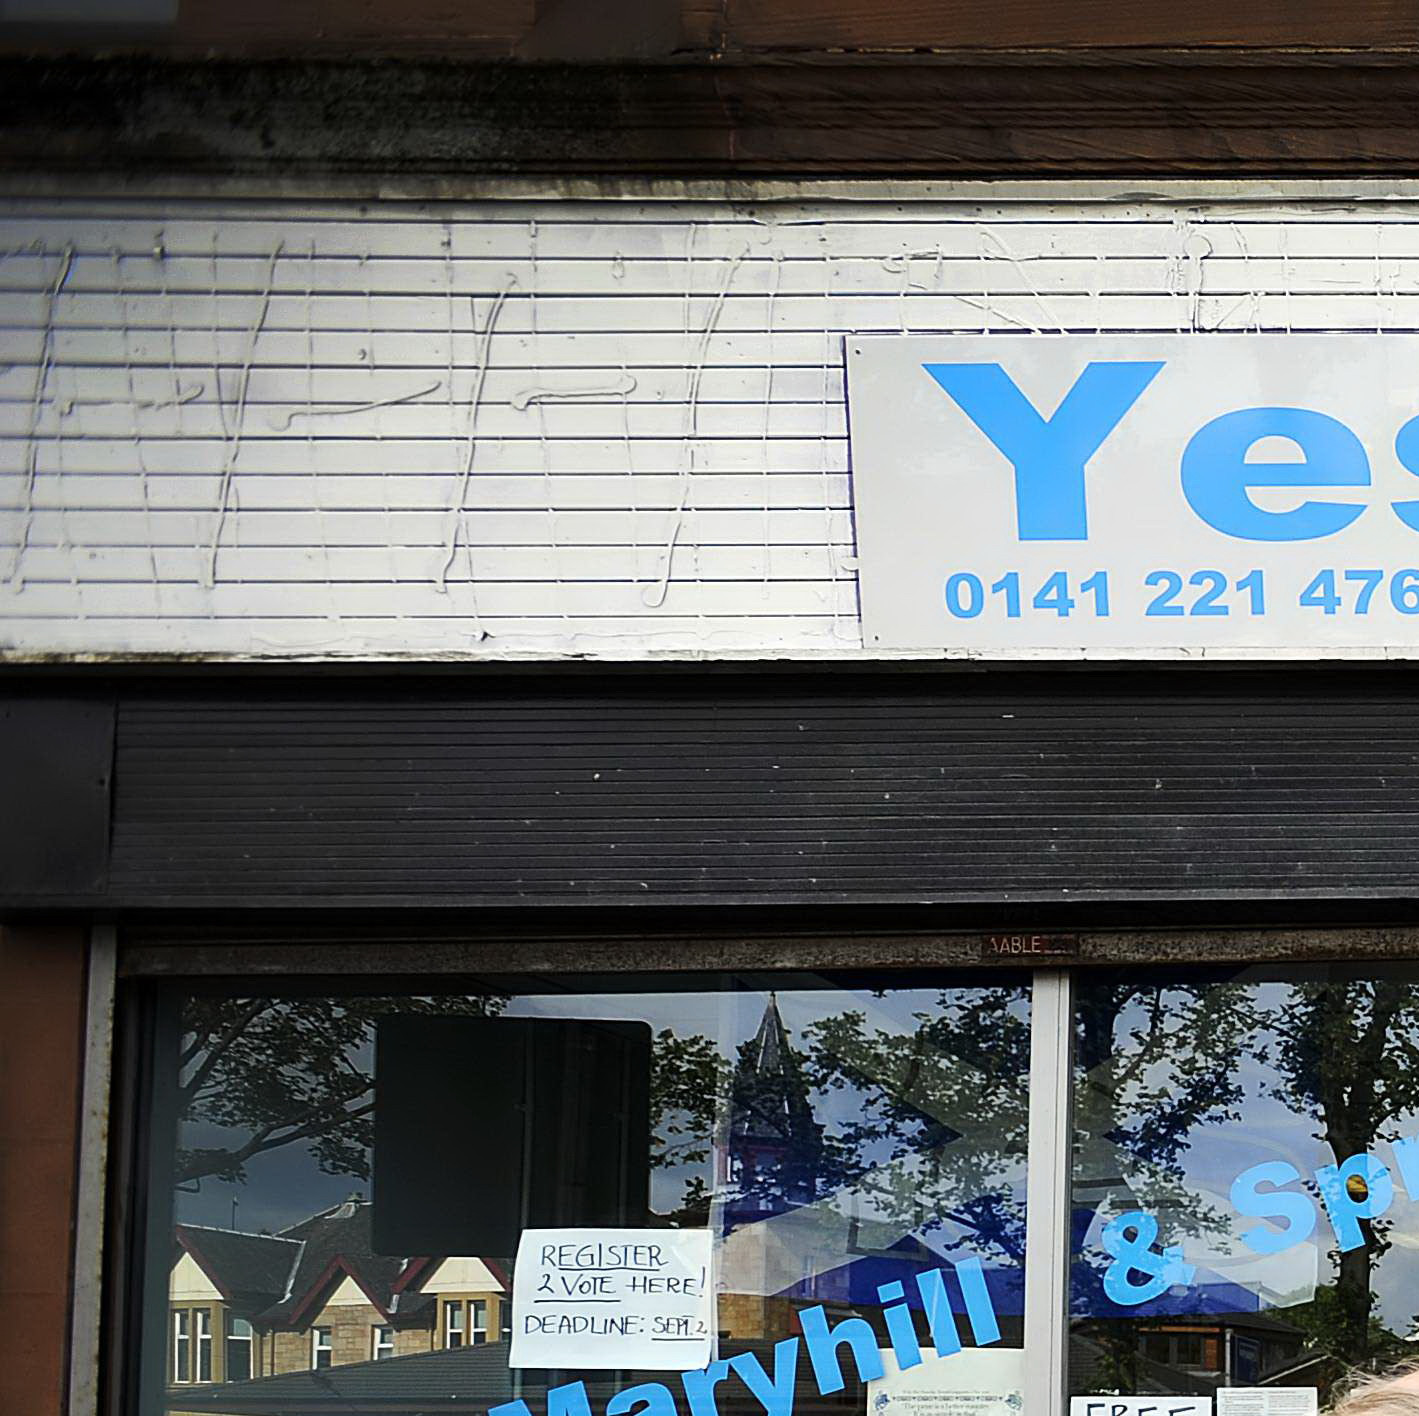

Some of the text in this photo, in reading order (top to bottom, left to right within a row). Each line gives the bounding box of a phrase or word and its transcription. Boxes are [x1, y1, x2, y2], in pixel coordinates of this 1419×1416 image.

[945, 571, 1112, 618] 0141
[1145, 569, 1266, 617] 221
[541, 1243, 669, 1268] REGISTER
[1103, 1211, 1196, 1306] &
[537, 1266, 706, 1298] 2 VOTE HERE!
[525, 1314, 645, 1336] DEADLINE:
